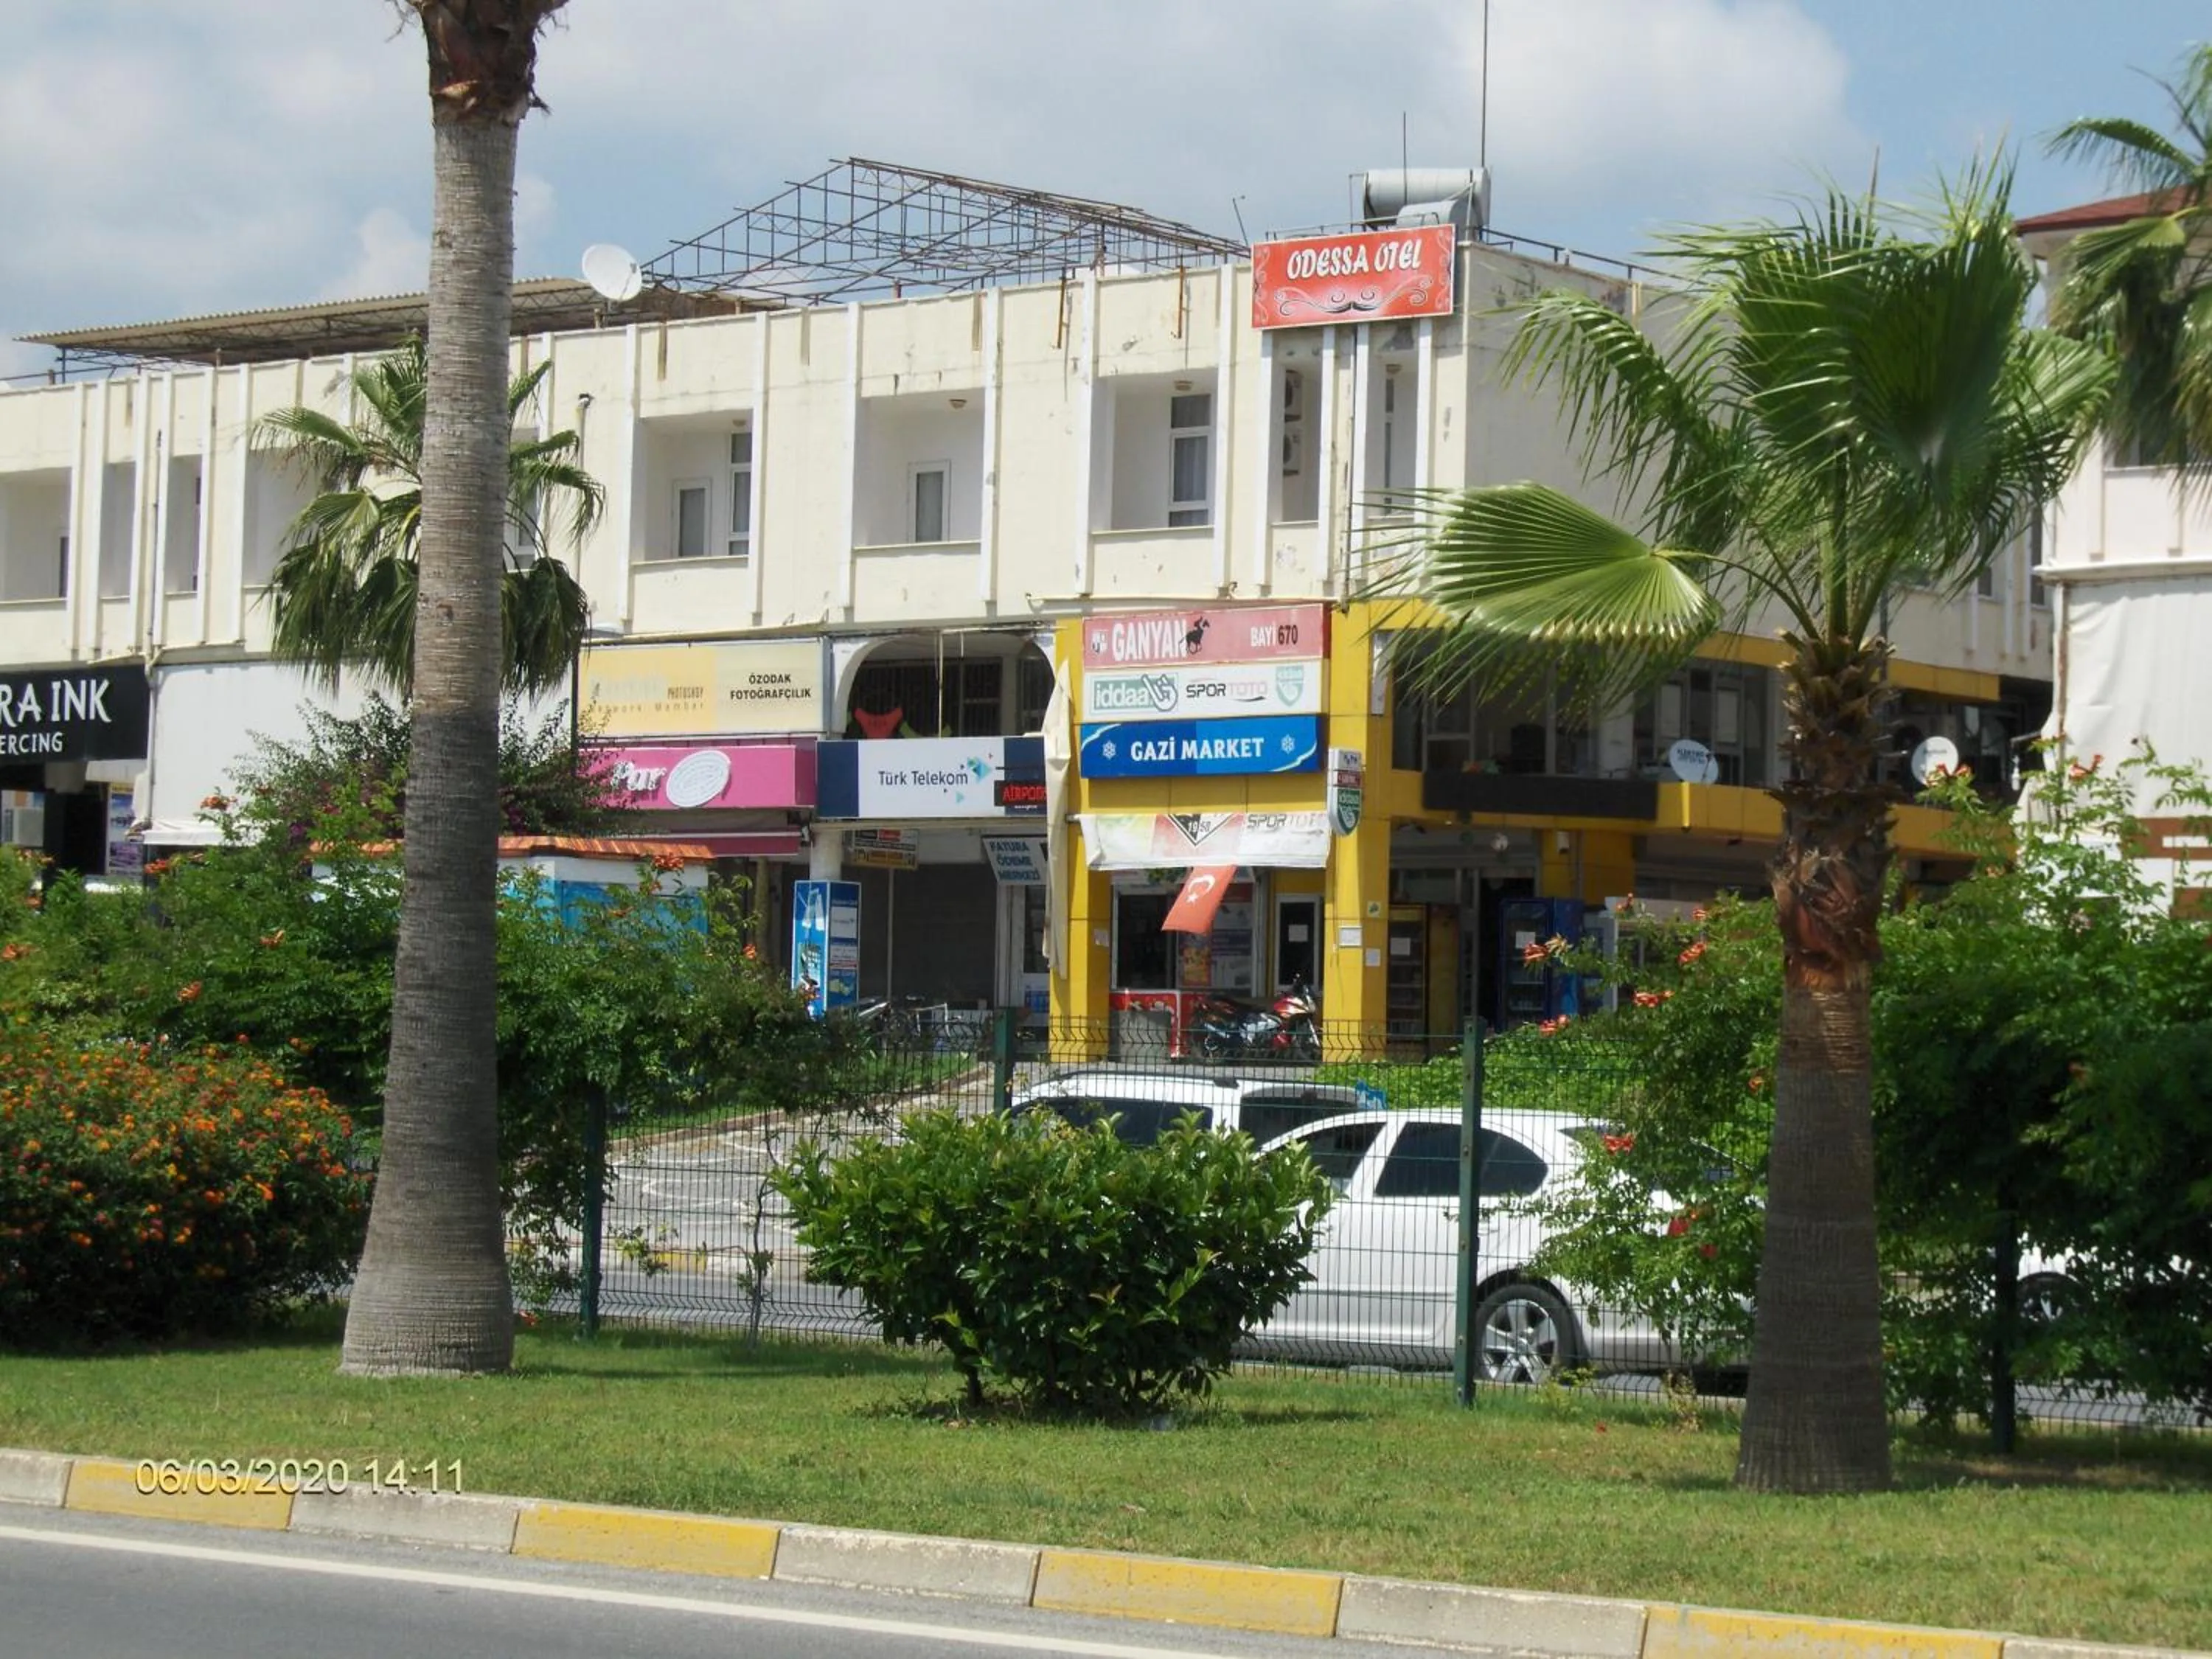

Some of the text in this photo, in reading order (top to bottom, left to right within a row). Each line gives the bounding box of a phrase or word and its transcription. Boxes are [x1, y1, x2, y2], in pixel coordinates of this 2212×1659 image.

[1287, 239, 1422, 279] ODESSA OTEL
[1112, 619, 1189, 661] GANYAN
[1278, 625, 1298, 645] 670
[748, 672, 791, 684] ÖZODAK
[51, 679, 113, 723] INK
[730, 688, 812, 700] FOTOĞRAFÇILIK
[1096, 683, 1150, 708] iddaa
[1130, 736, 1265, 762] GAZİ MARKET
[878, 771, 968, 785] Türk Telekom
[990, 841, 1030, 852] FATURA
